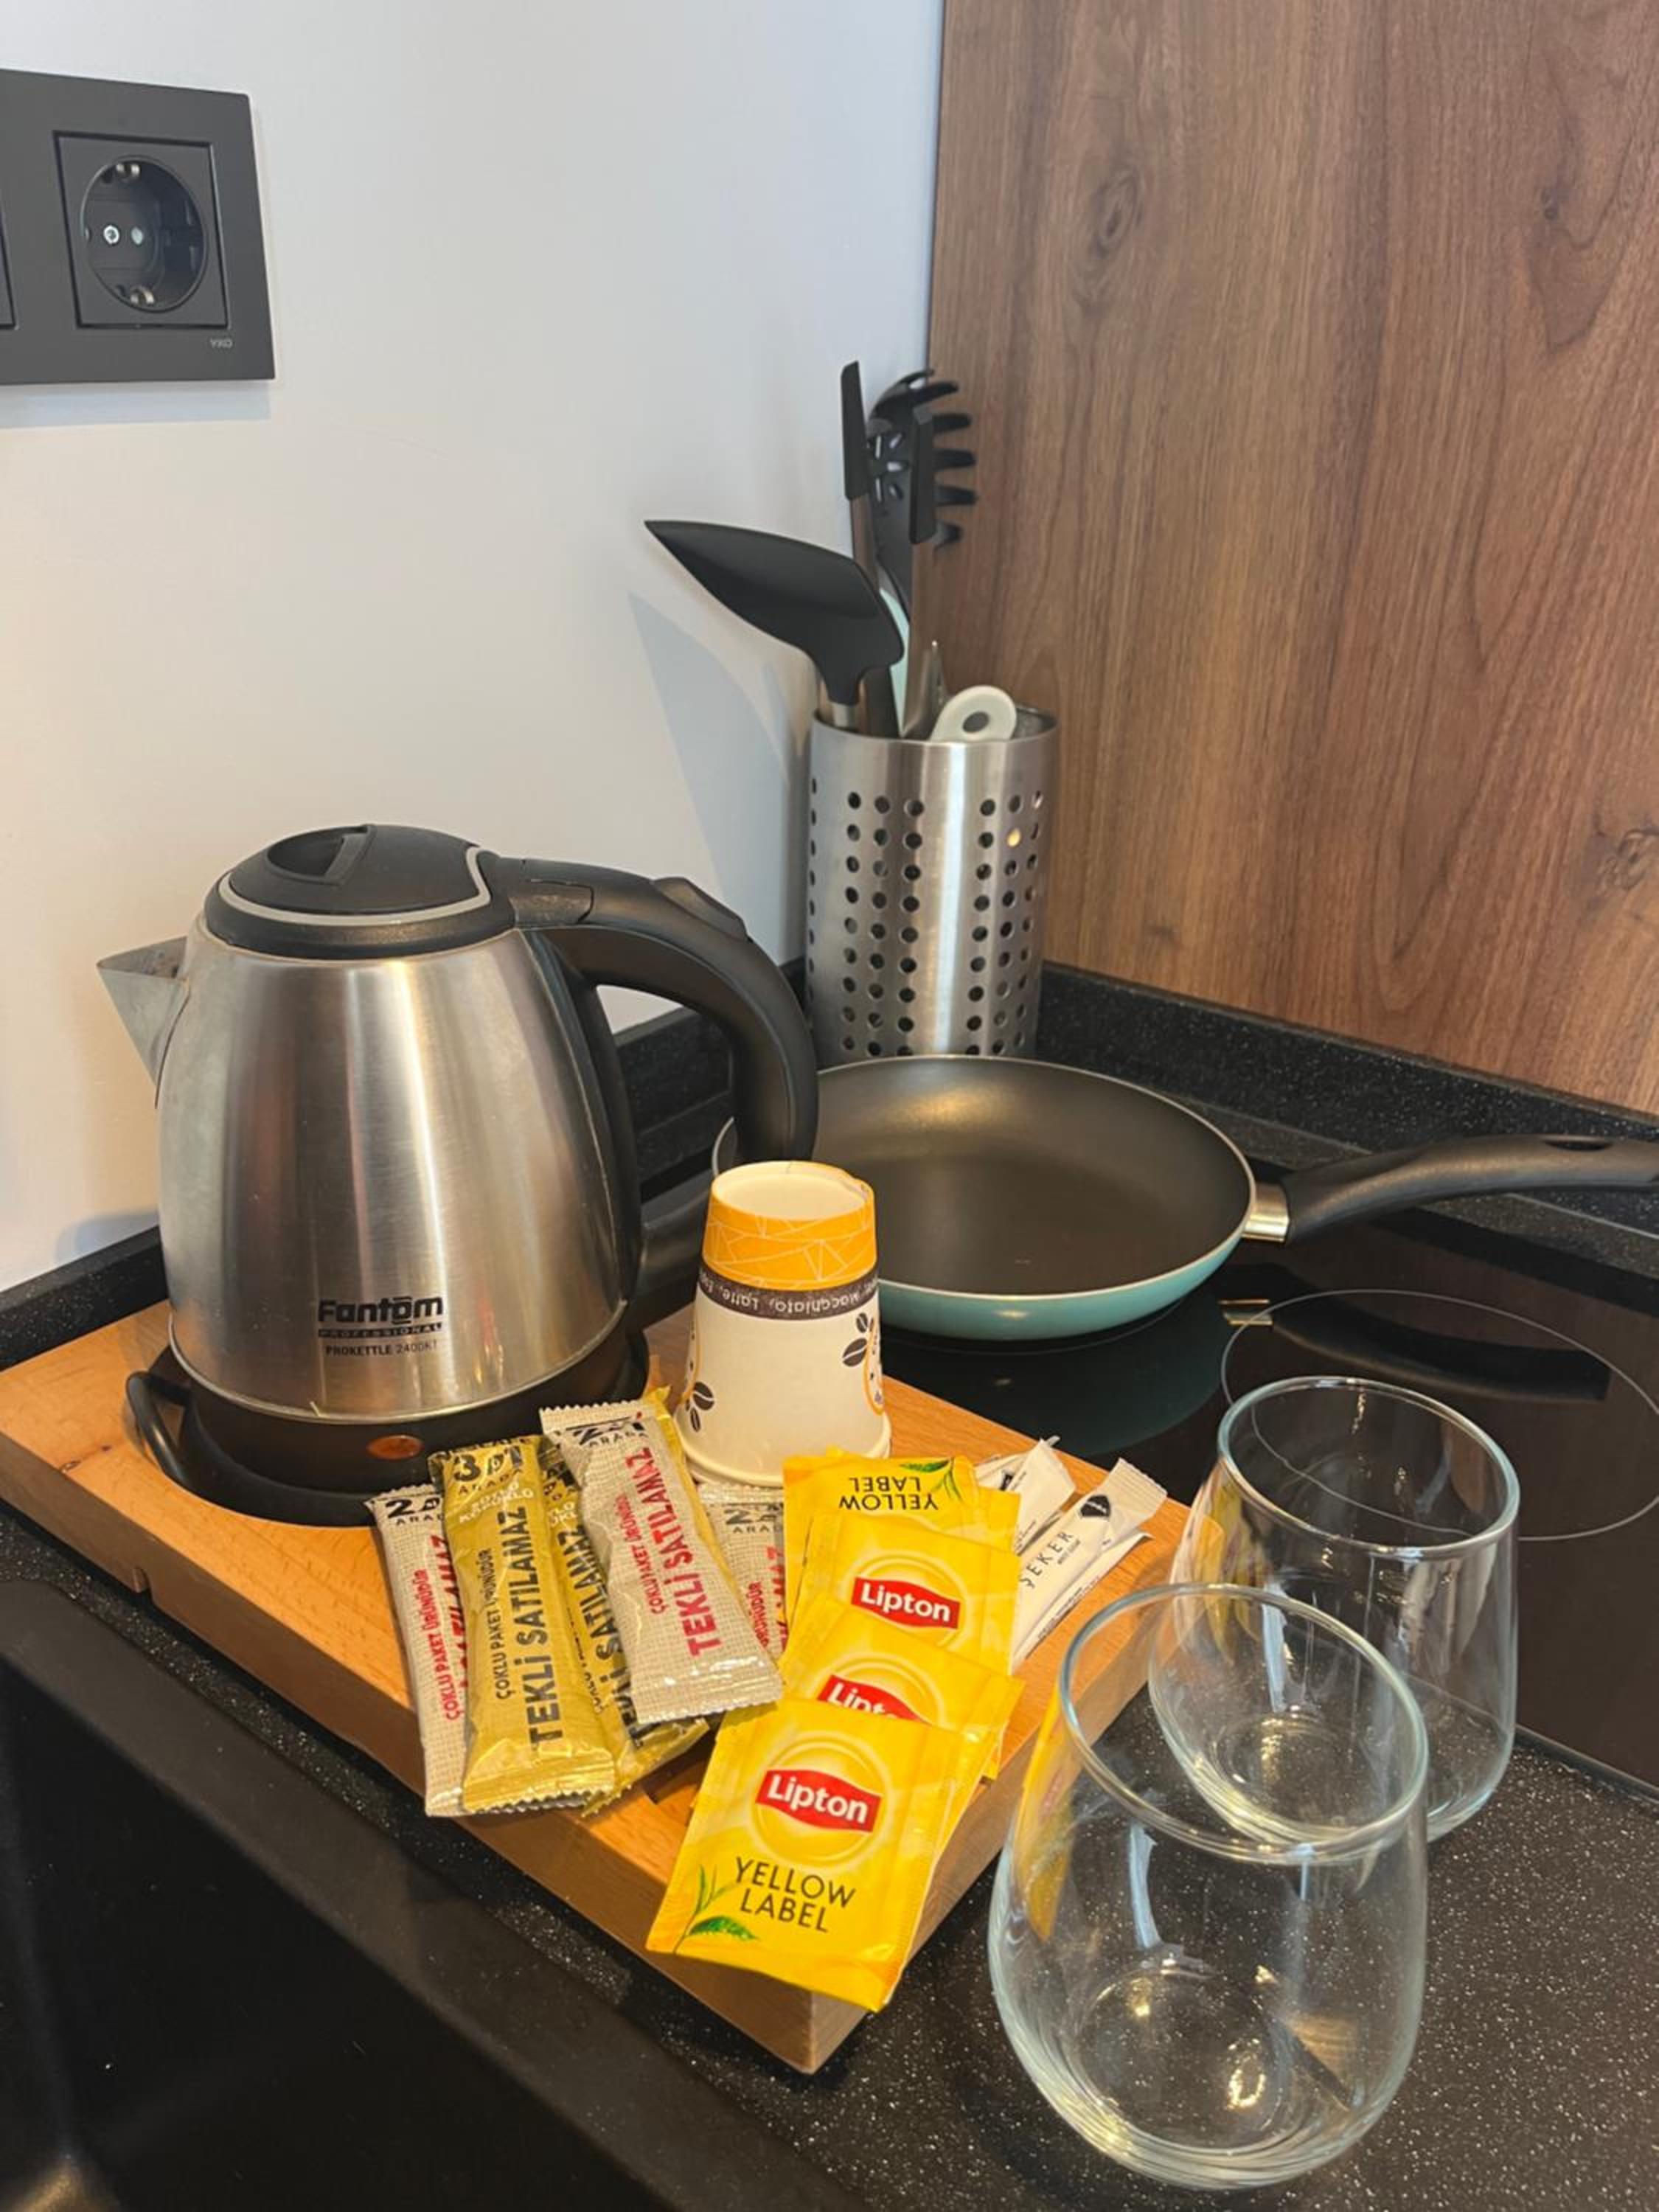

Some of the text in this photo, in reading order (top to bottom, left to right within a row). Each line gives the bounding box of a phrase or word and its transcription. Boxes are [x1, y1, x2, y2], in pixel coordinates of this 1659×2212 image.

[326, 1345, 392, 1357] PROKETTLE
[838, 1492, 939, 1511] YELLOW
[849, 1475, 921, 1493] LABEL
[625, 1447, 722, 1657] TEKLİ SATILAMAZ
[860, 1582, 951, 1622] Lipton
[487, 1610, 506, 1652] PAKET
[497, 1506, 563, 1746] TEKLİ SATILAMAZ
[428, 1633, 450, 1675] PAKET
[491, 1654, 516, 1700] ÇOKLU
[767, 1773, 869, 1824] Lipton
[735, 1856, 856, 1908] YELLOW
[740, 1888, 828, 1933] LABEL
